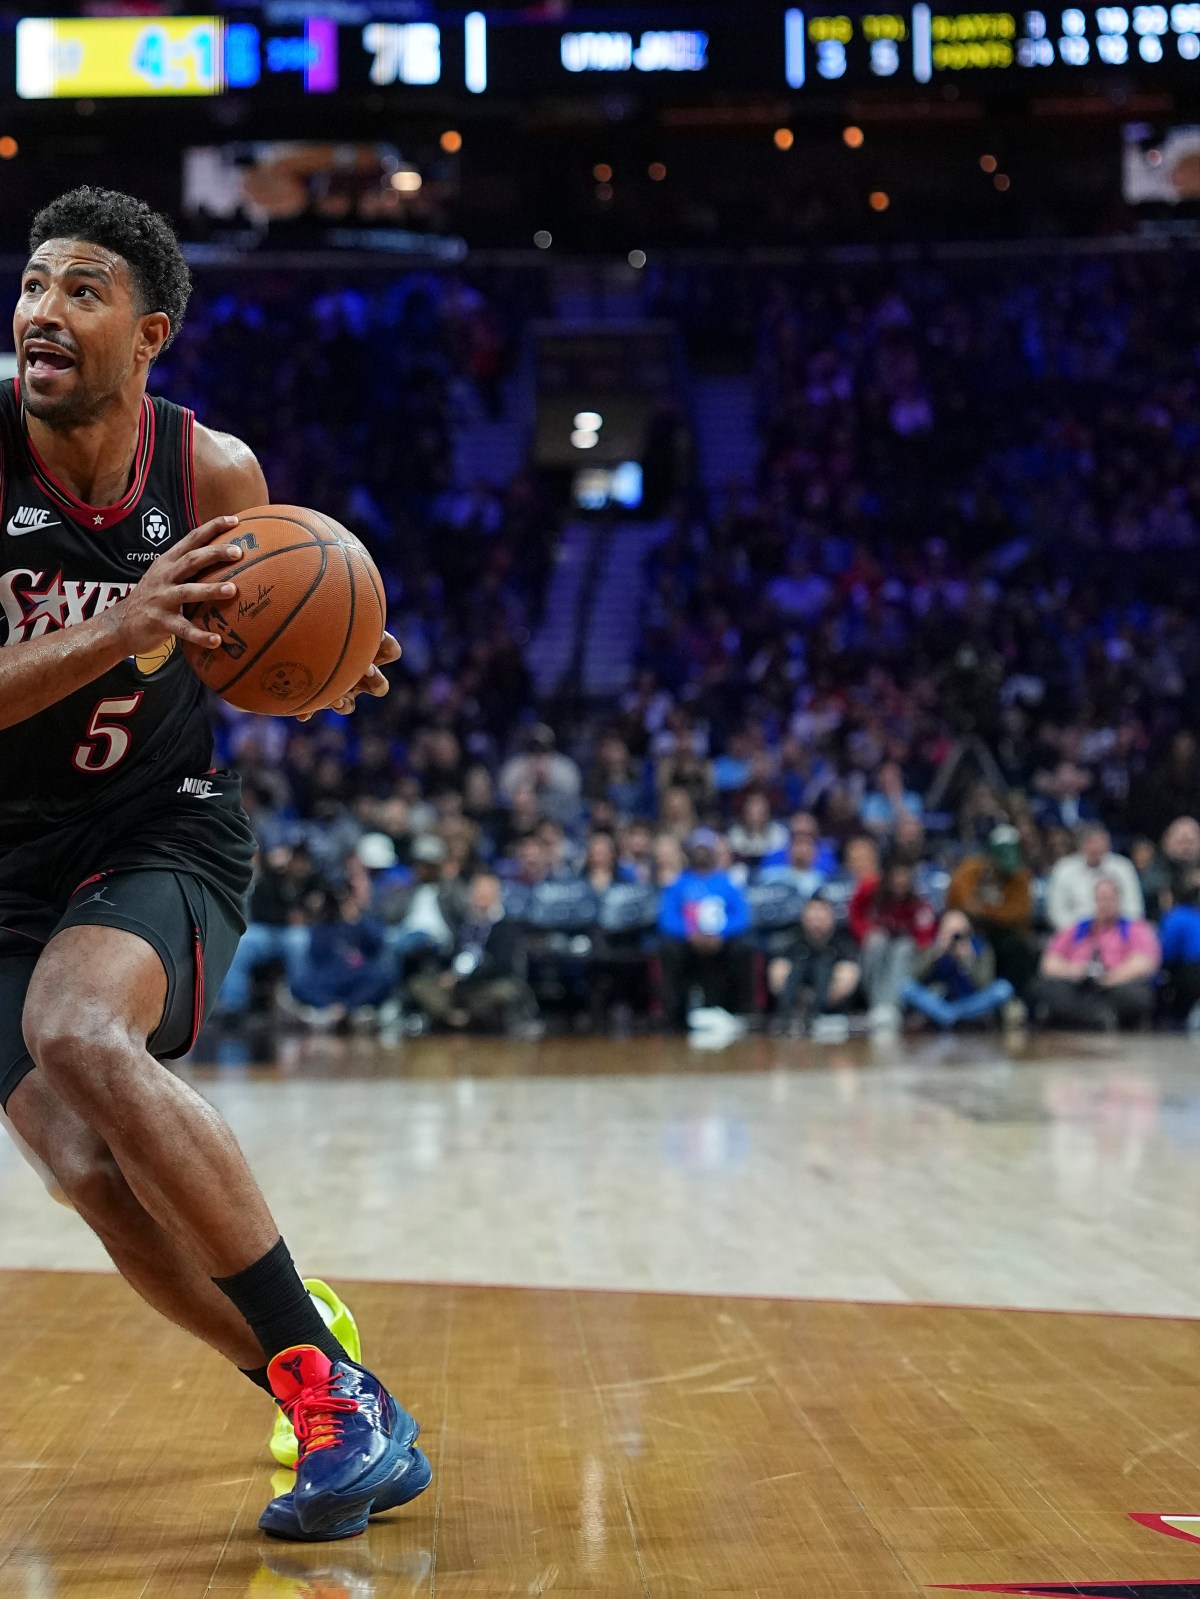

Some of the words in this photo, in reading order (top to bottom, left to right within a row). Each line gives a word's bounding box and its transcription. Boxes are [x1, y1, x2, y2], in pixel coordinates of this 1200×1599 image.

[13, 506, 51, 525] NIKE
[71, 691, 144, 774] 5
[182, 777, 213, 795] NIKE
